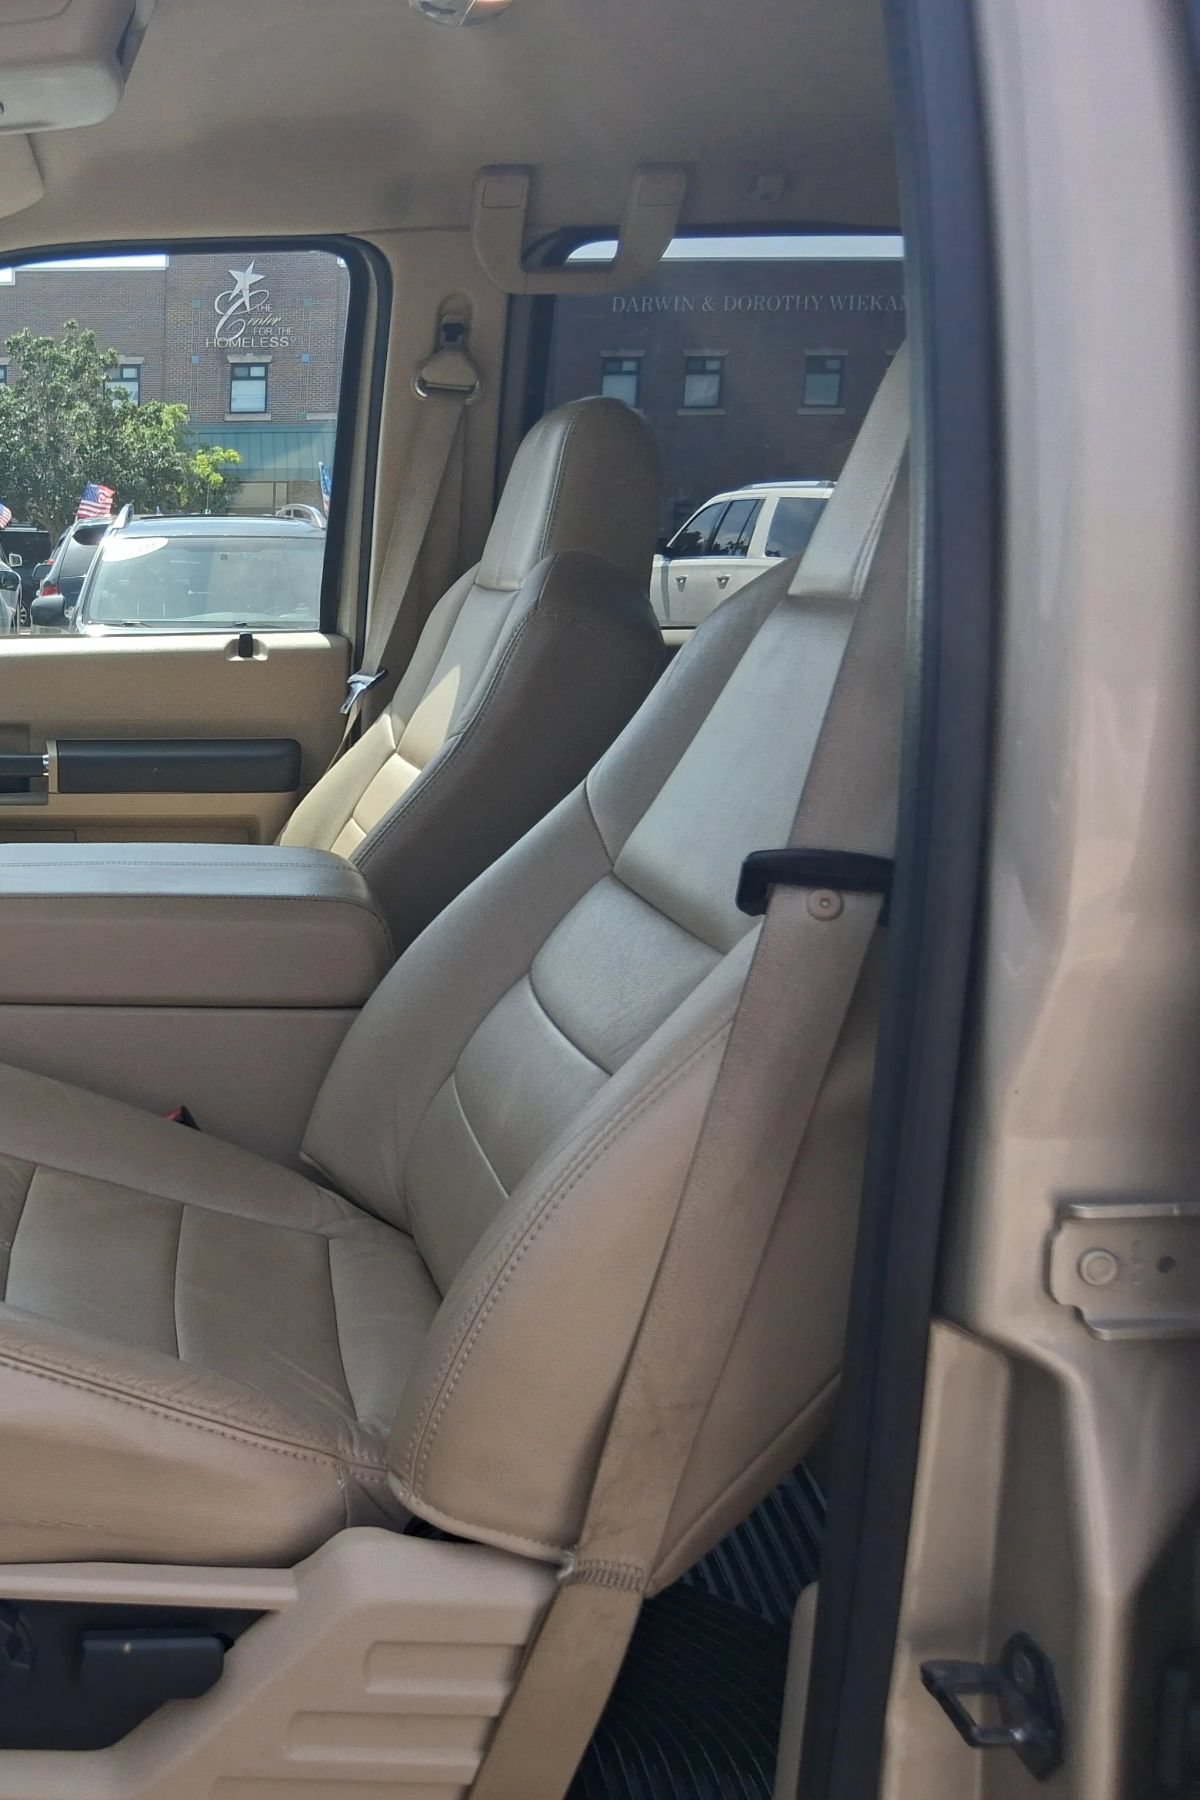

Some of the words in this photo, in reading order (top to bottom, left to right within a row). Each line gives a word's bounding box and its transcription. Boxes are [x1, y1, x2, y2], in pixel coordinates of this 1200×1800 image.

[256, 303, 274, 313] THE
[612, 295, 695, 313] DARWIN
[702, 295, 716, 312] &
[723, 295, 824, 312] DOROTHY
[253, 327, 273, 336] FOR
[277, 327, 295, 336] THE
[205, 337, 290, 348] HOMELESS
